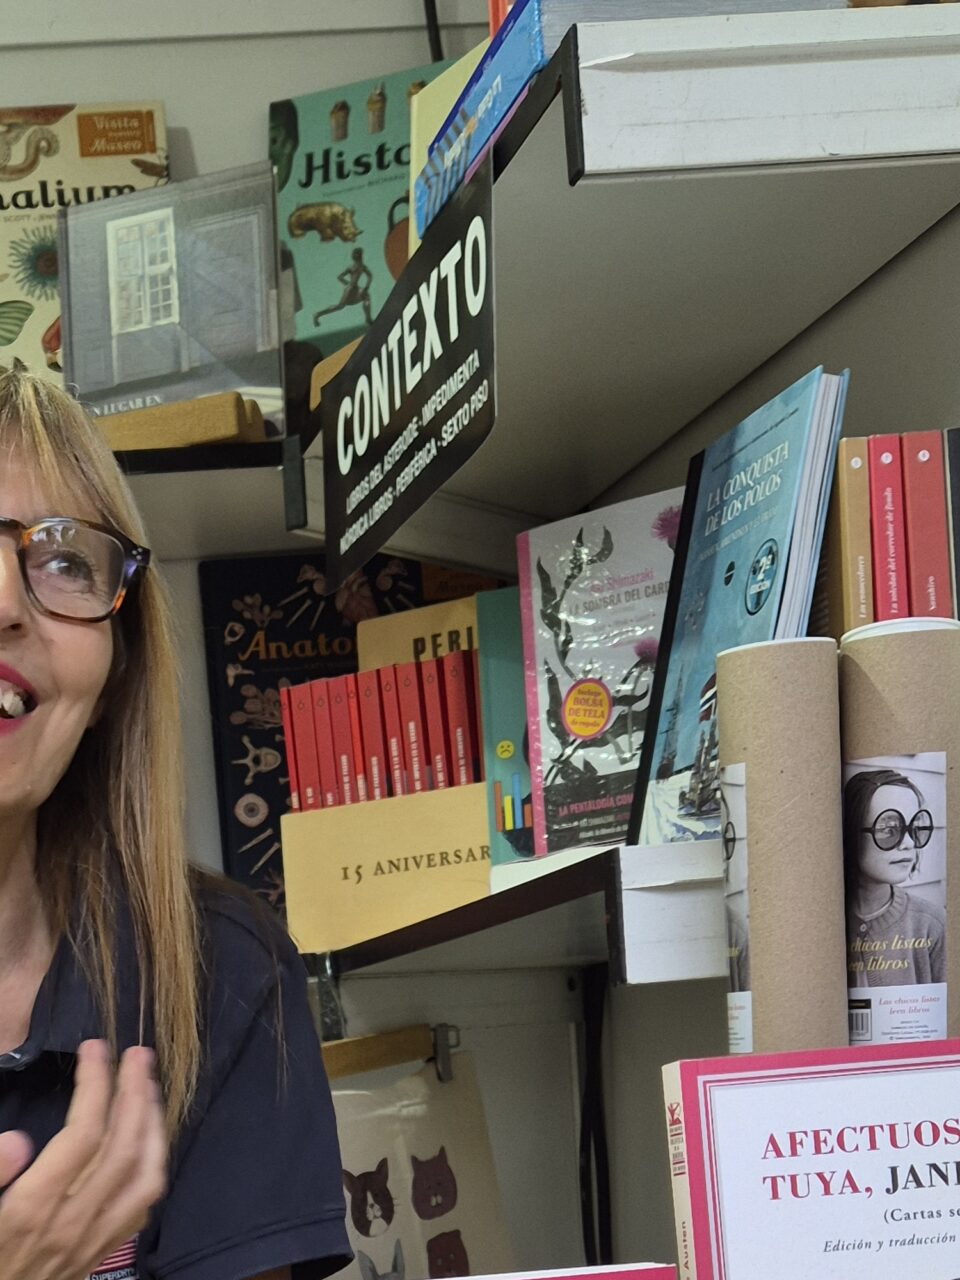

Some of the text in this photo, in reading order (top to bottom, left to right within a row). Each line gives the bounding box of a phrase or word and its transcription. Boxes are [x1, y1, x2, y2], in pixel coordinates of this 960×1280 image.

[337, 215, 487, 476] CONTEXTO
[346, 349, 481, 516] LIBROS DEL ASTEROIDE IMPEDIMENTA
[369, 485, 394, 527] LIBROS
[395, 437, 438, 497] PERIFÉRICA
[441, 402, 470, 447] SEXTO
[471, 378, 489, 418] PISO
[707, 440, 789, 513] LA CONQUISTA
[705, 510, 721, 537] DE
[721, 497, 742, 526] LOS
[744, 469, 784, 512] POLOS
[884, 511, 893, 522] de
[885, 522, 896, 557] corredor
[887, 557, 896, 570] del
[888, 571, 898, 602] soledad
[582, 707, 606, 719] TELA
[341, 845, 492, 884] 15 ANIVERSAR
[891, 934, 933, 949] listas
[867, 956, 910, 970] libros
[762, 1168, 873, 1201] TUYA,
[884, 1208, 942, 1225] (Cartas
[680, 1220, 690, 1271] Austen
[823, 1233, 956, 1253] Edición y traducción
